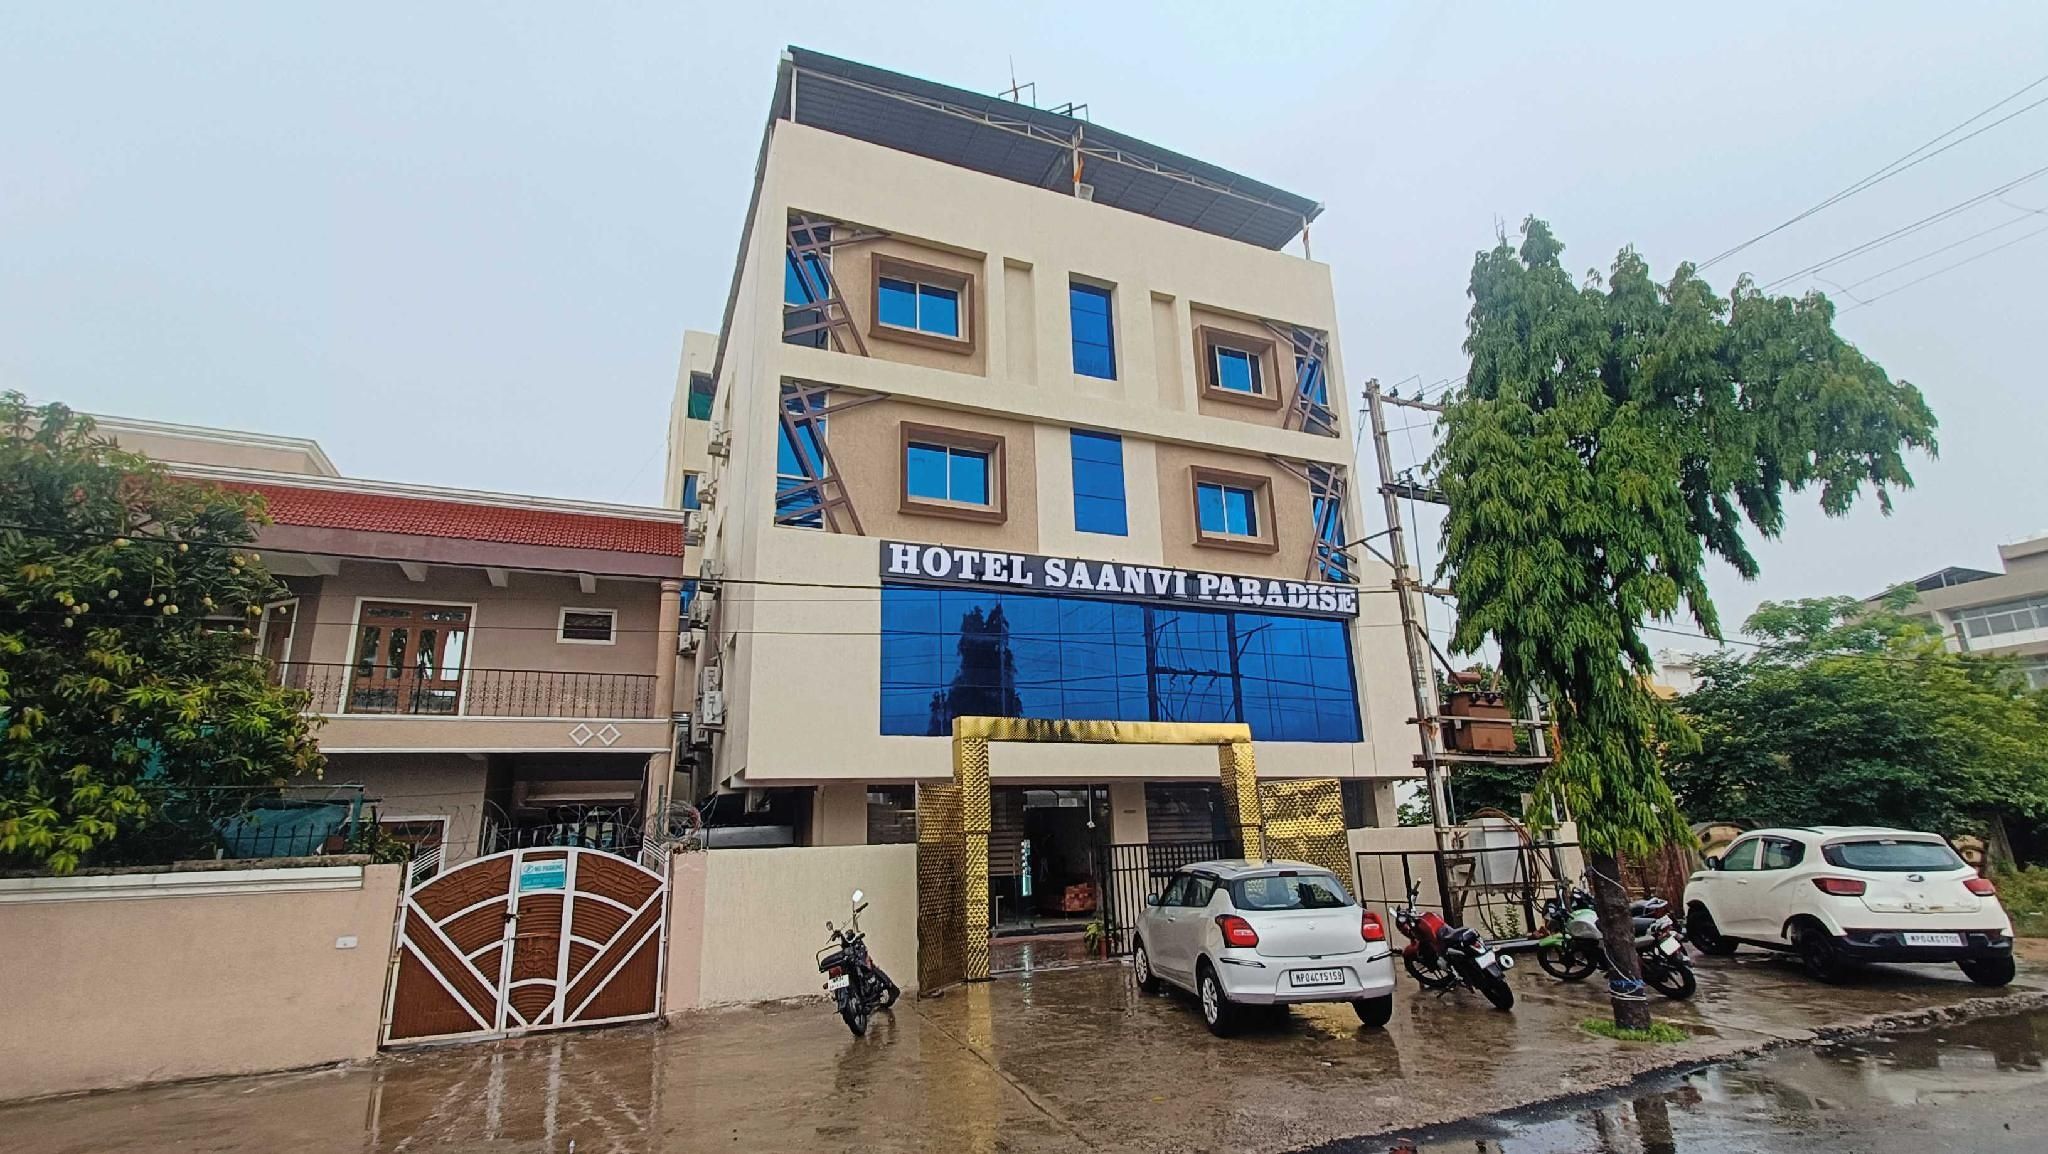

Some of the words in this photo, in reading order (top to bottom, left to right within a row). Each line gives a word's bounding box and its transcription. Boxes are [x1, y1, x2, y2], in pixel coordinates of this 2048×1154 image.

[888, 543, 1033, 584] HOTEL
[1044, 558, 1188, 598] SAANVI
[1198, 573, 1356, 613] PARADISE
